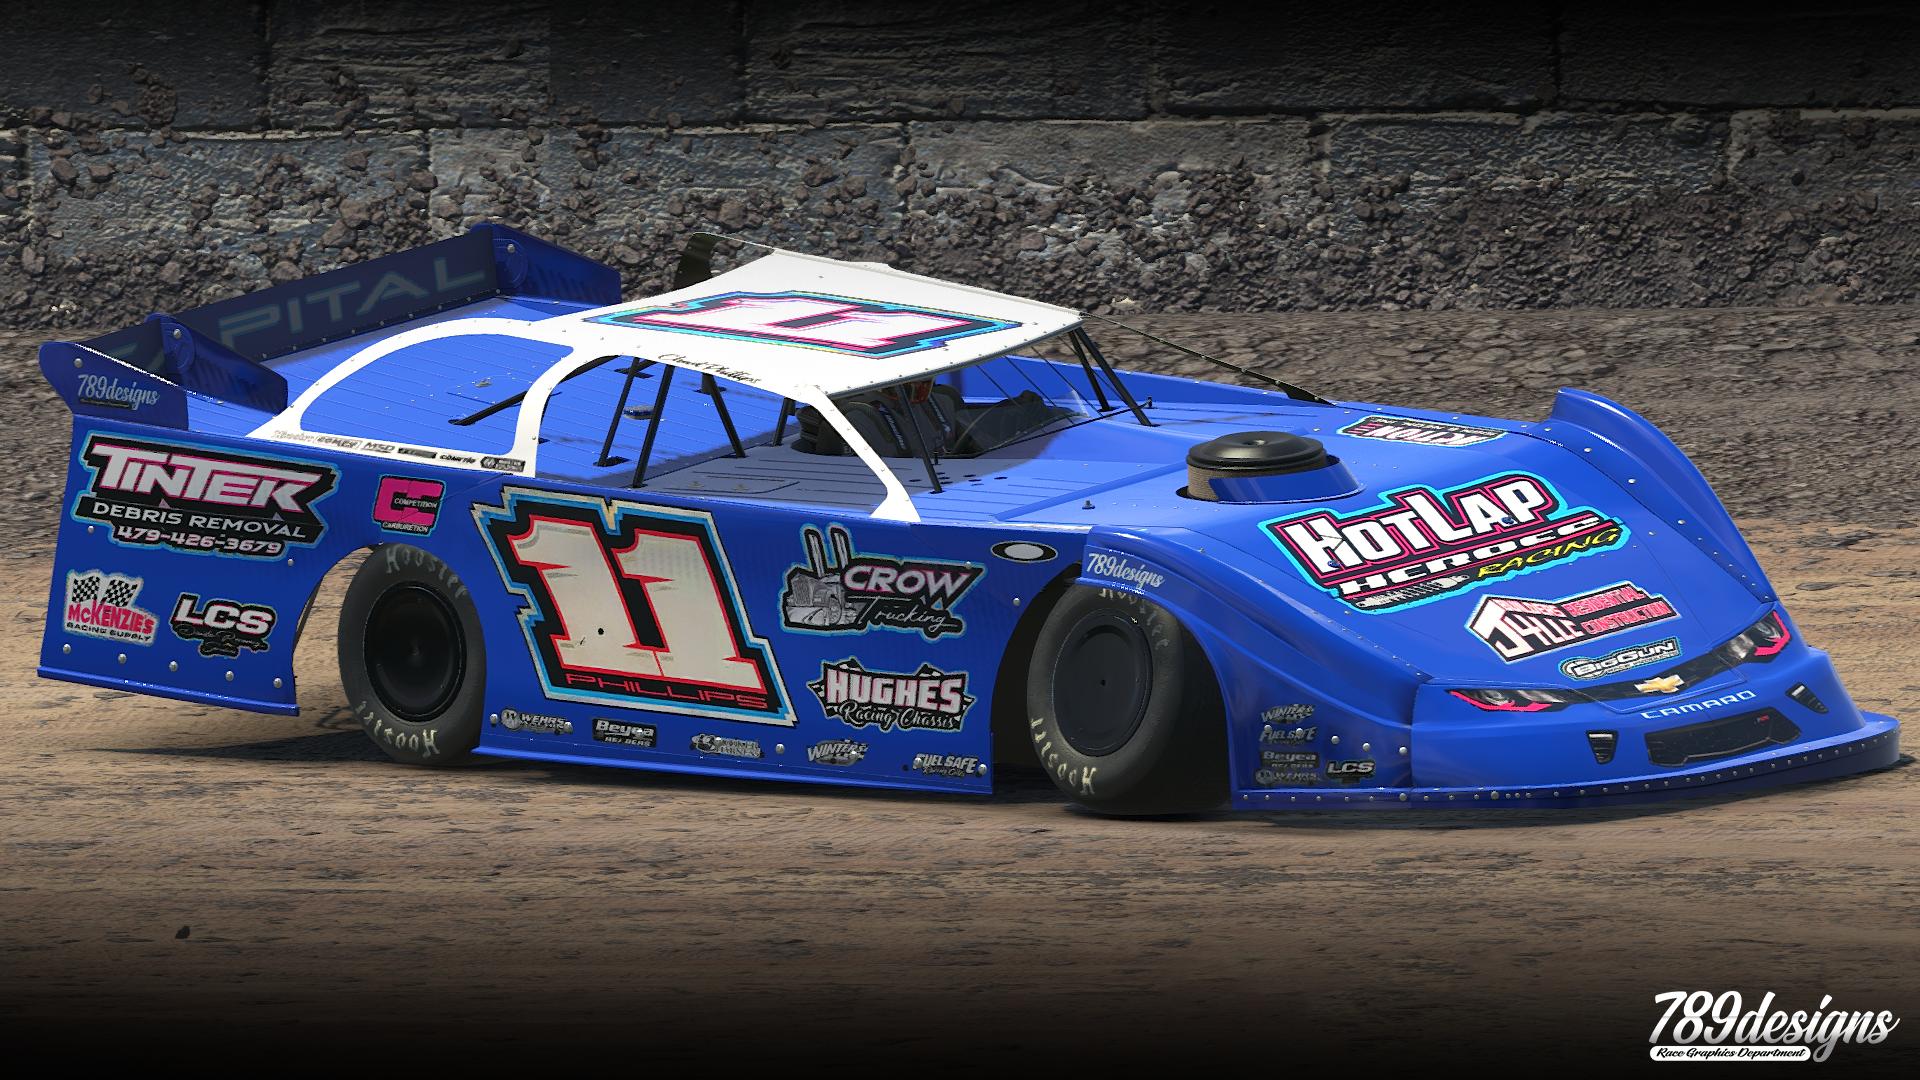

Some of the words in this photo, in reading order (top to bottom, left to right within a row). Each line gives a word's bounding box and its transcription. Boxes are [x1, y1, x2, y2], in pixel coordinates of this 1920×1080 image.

[77, 374, 160, 410] 789designs
[91, 443, 322, 513] TINTEK
[92, 501, 182, 525] DEBRIS
[188, 514, 306, 539] REMOVAL
[394, 498, 438, 509] COMPETITION
[116, 525, 284, 554] 479-426-3679
[1478, 527, 1620, 578] RACING
[844, 565, 969, 599] CROW
[1086, 553, 1166, 590] 789designs
[174, 600, 272, 634] LCS
[507, 514, 768, 695] 11
[848, 595, 961, 632] Trucking
[1561, 585, 1647, 617] RESIDENTIAL
[1580, 601, 1672, 635] CONSTRUCTION
[67, 622, 108, 635] RACING
[109, 629, 152, 642] SUPPLY
[566, 674, 768, 709] PHILLIPS
[826, 668, 964, 713] HUGHES
[1640, 690, 1757, 719] CAMARO
[521, 713, 566, 726] WEHRS
[840, 701, 893, 725] Racing
[900, 707, 955, 728] Chassis
[912, 753, 944, 770] FUEL
[943, 756, 978, 774] SAFE
[1327, 762, 1376, 774] LCS
